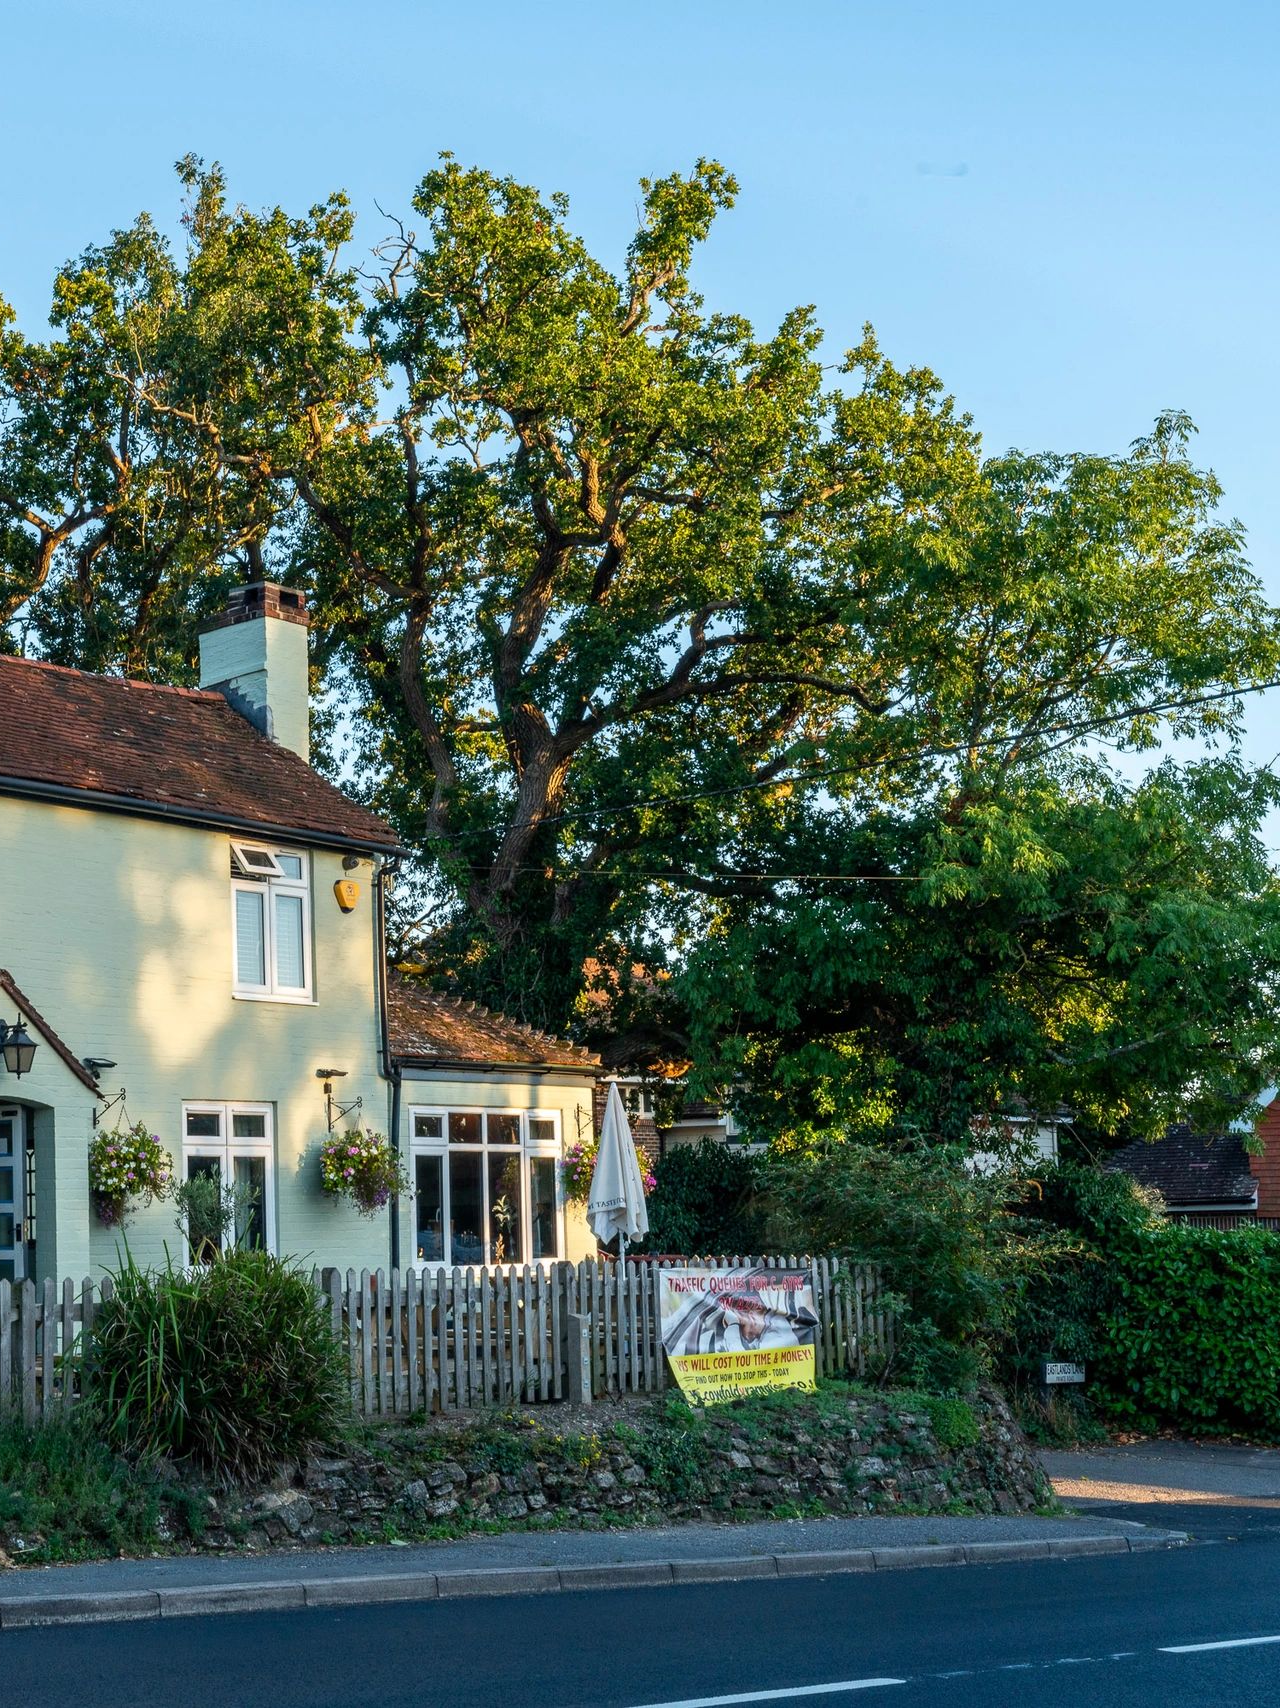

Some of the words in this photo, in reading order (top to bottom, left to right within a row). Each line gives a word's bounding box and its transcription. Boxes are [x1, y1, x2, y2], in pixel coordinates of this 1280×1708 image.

[668, 1277, 706, 1292] TRAFFIC
[709, 1276, 747, 1294] QUEUES
[749, 1276, 768, 1292] FOR
[770, 1276, 780, 1291] C.
[782, 1276, 804, 1291] 6YRS
[719, 1296, 734, 1311] ON
[691, 1358, 710, 1371] WILL
[713, 1356, 733, 1369] COST
[735, 1355, 751, 1367] YOU
[754, 1353, 771, 1366] TIME
[773, 1352, 779, 1364] &
[781, 1349, 813, 1363] MONEY!
[695, 1375, 707, 1384] FIND
[708, 1374, 719, 1383] OUT
[720, 1373, 733, 1382] HOW
[734, 1372, 742, 1381] TO
[743, 1371, 756, 1380] STOP
[757, 1370, 768, 1379] THIS
[773, 1368, 789, 1377] TODAY
